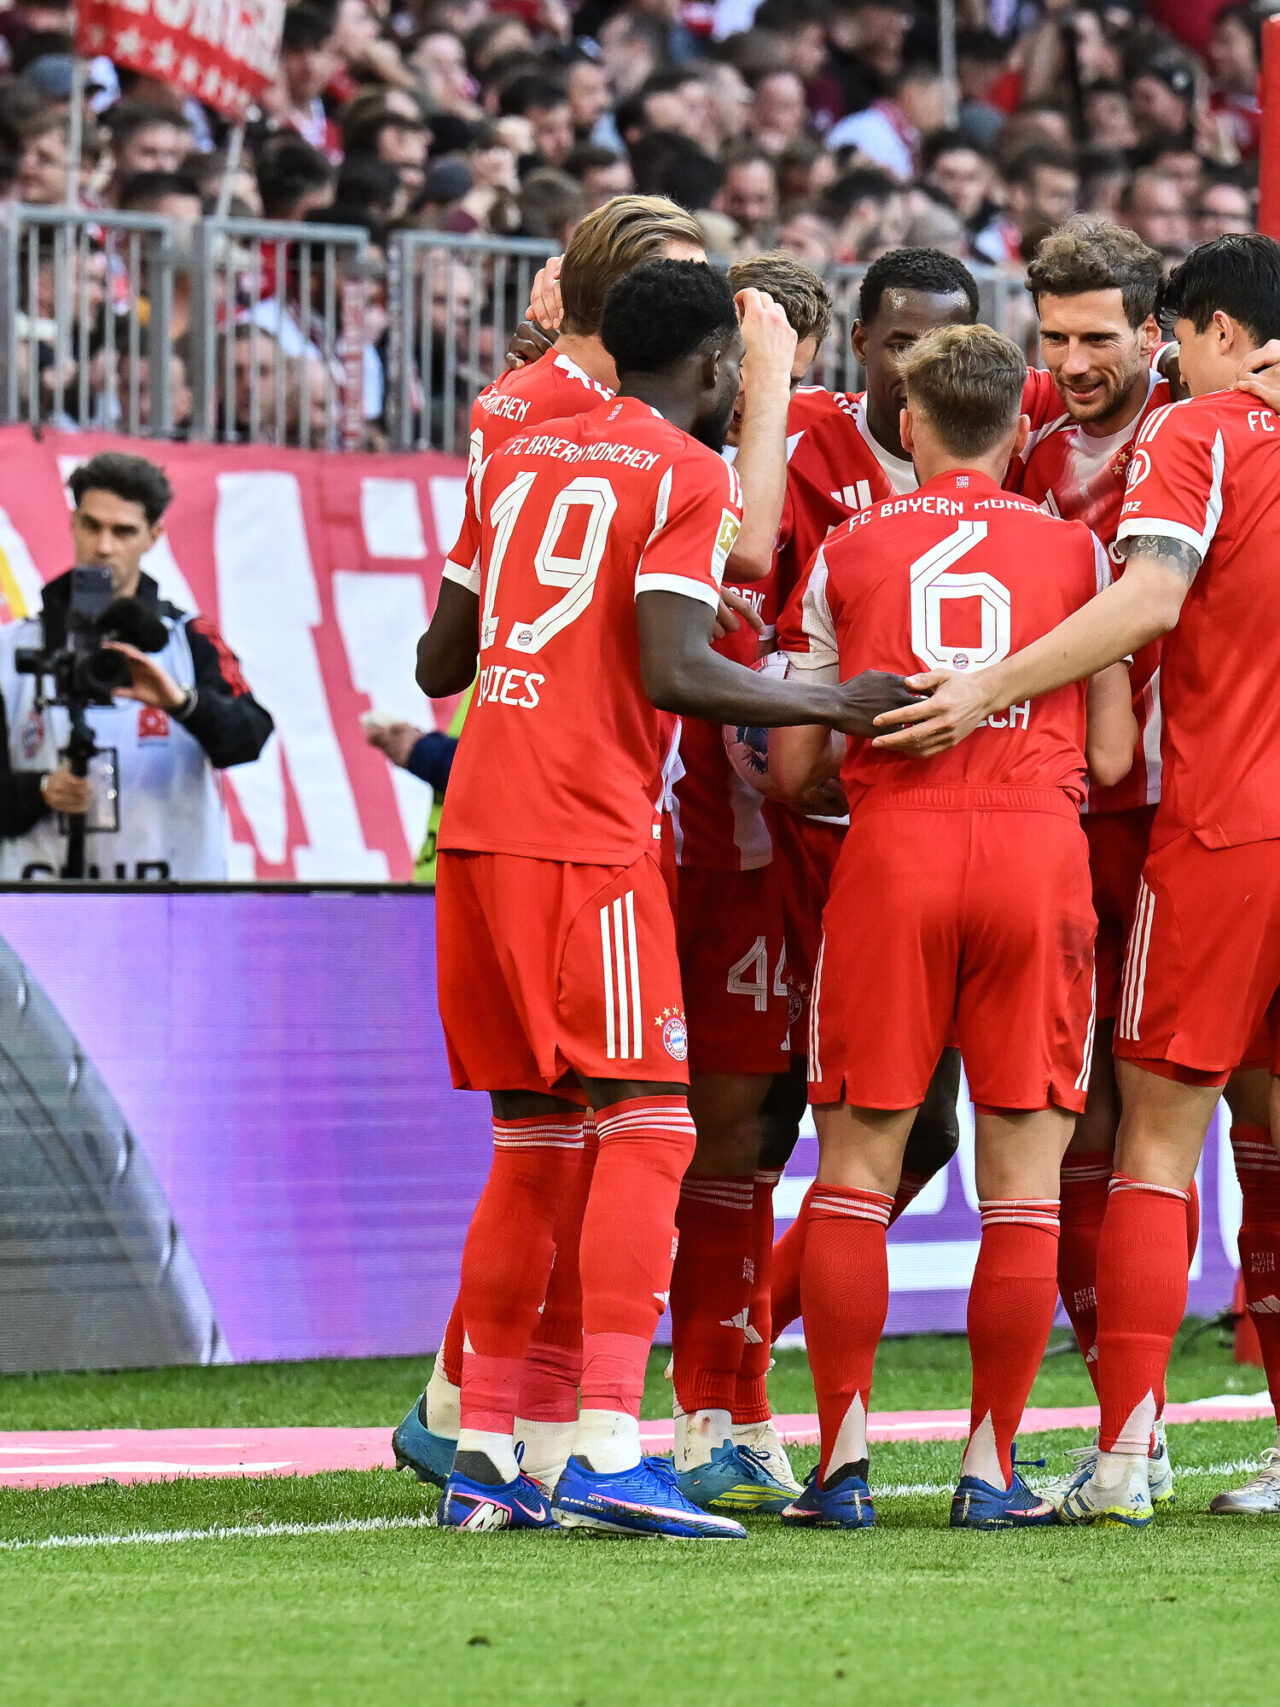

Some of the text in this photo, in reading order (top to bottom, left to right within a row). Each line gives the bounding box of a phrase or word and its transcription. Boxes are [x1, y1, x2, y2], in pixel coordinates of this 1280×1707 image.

[1247, 410, 1276, 432] FC
[503, 437, 530, 456] FC
[524, 435, 584, 463] BAYERN
[848, 510, 872, 533] FC
[880, 496, 965, 518] BAYERN
[479, 471, 619, 655] 19
[909, 520, 1012, 674] 6
